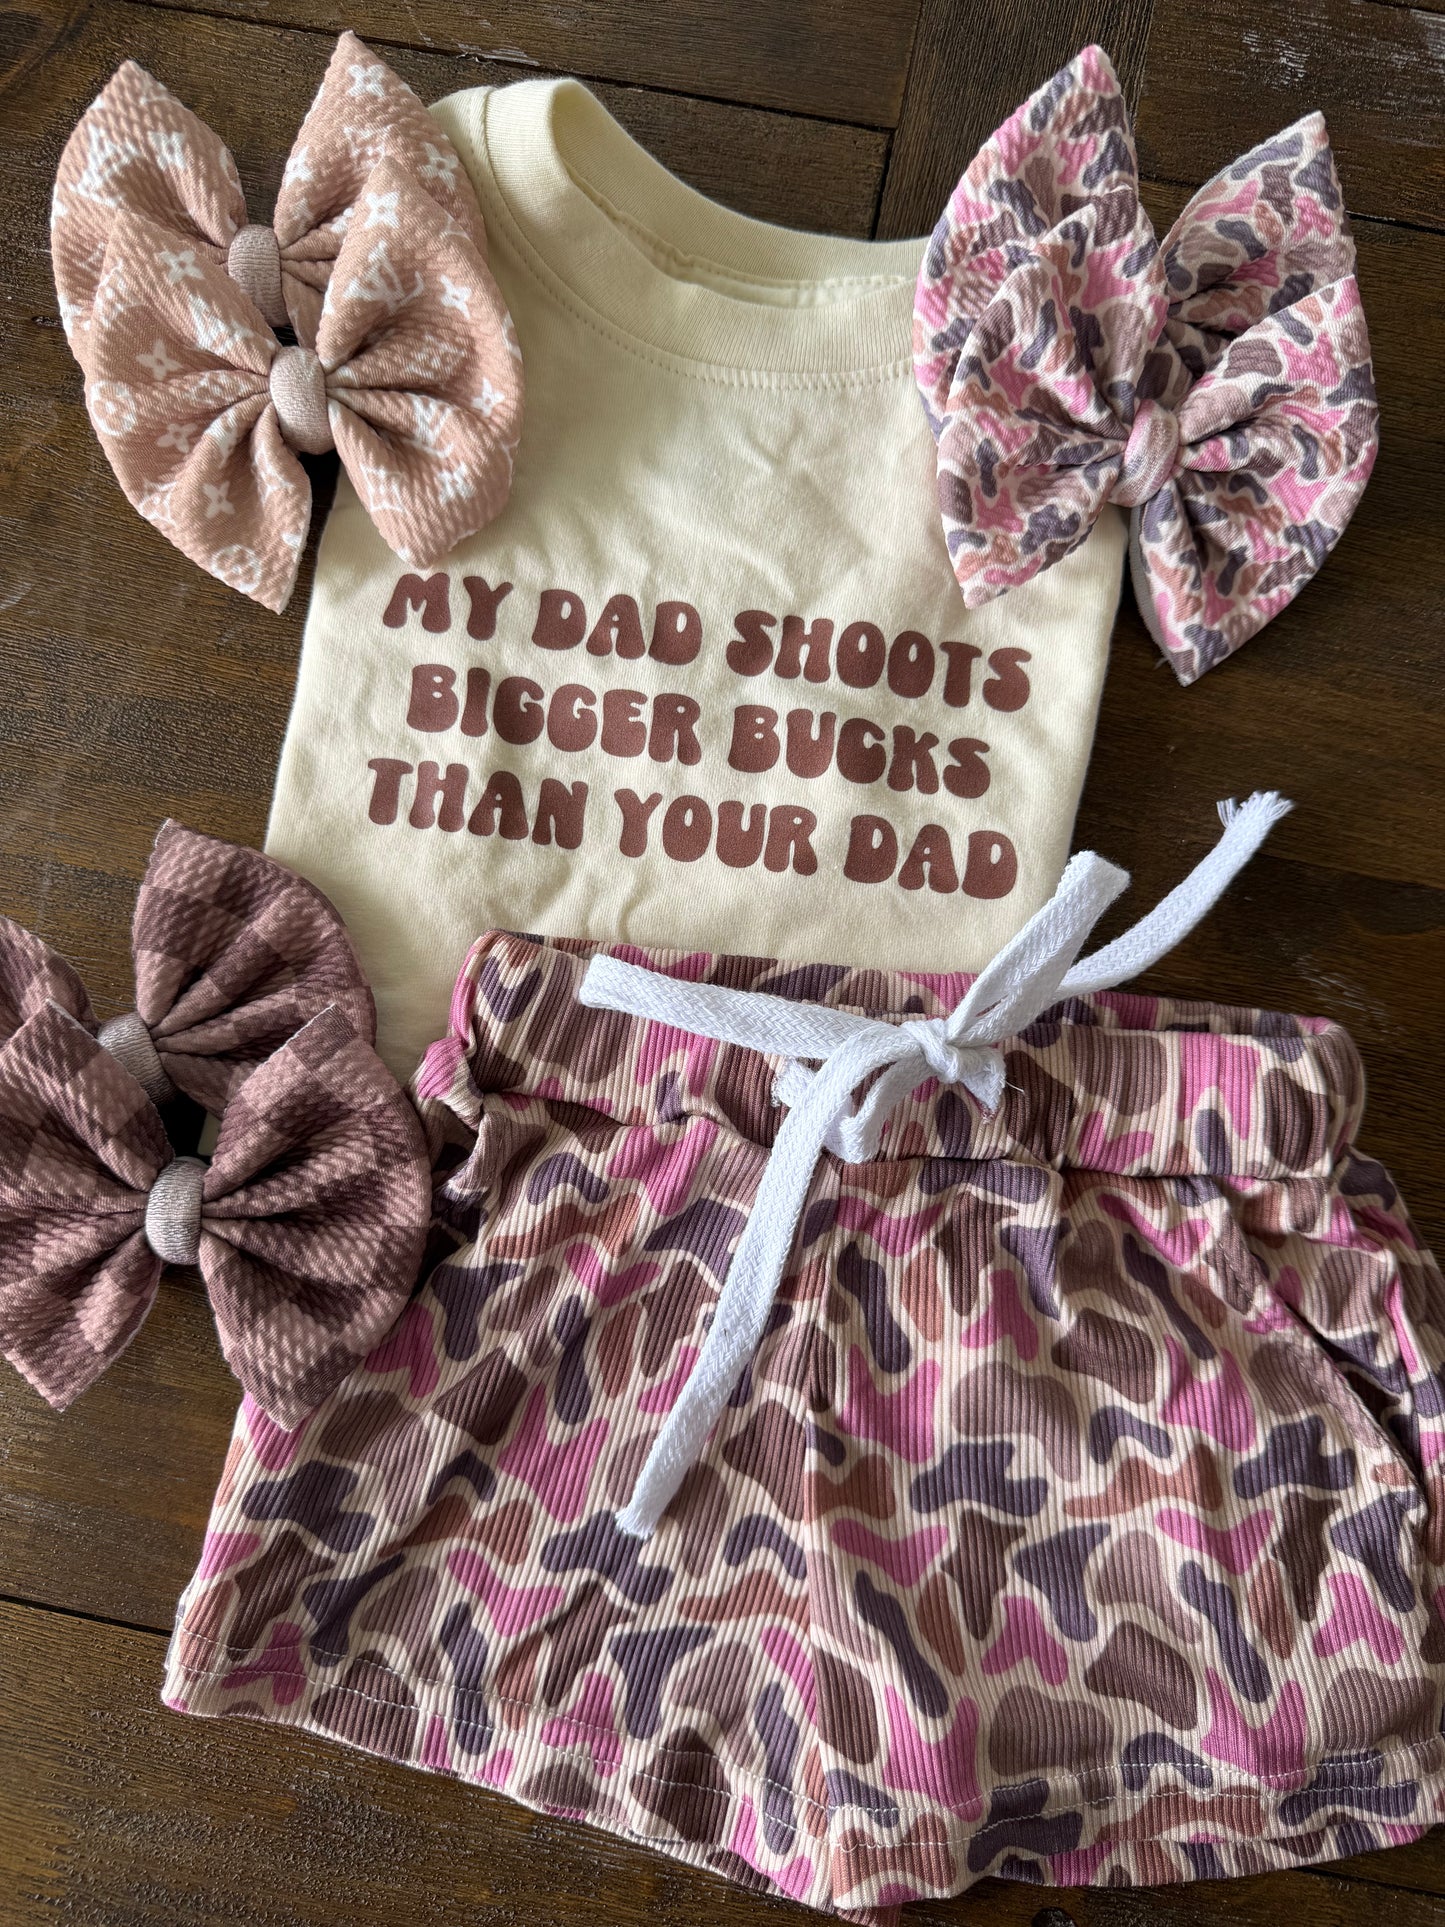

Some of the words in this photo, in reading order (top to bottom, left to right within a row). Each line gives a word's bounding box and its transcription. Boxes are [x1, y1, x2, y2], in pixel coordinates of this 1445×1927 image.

[383, 572, 513, 640] MY
[532, 589, 702, 665] DAD
[726, 610, 1031, 712] SHOOTS
[407, 664, 701, 765] BIGGER
[728, 705, 990, 798] BUCKS
[368, 759, 588, 850] THAN
[614, 789, 817, 876] YOUR
[844, 815, 1017, 899] DAD
